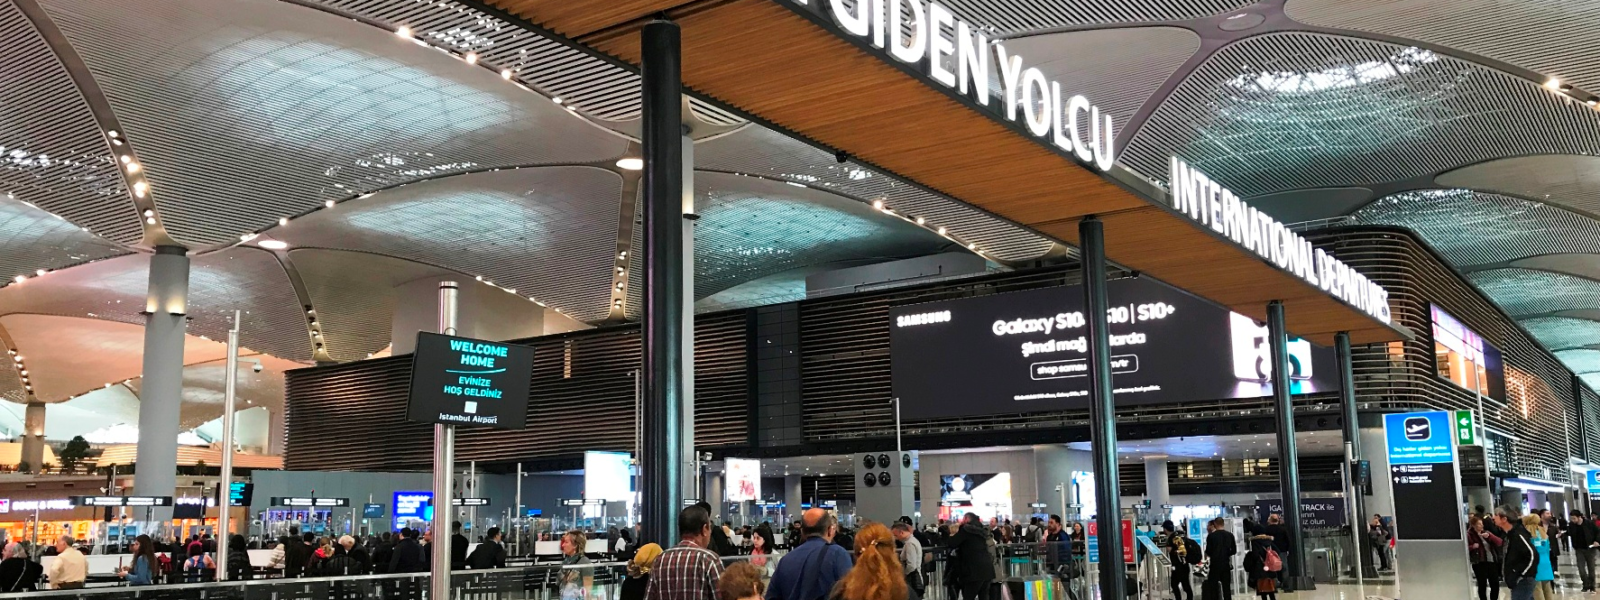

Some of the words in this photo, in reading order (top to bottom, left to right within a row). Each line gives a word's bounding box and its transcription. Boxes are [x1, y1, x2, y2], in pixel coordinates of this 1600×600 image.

[990, 41, 1114, 172] YOLCU
[1169, 156, 1319, 286] INTERNATIONAL
[1314, 247, 1391, 325] DEPARTURES
[897, 310, 951, 327] SAMSUNG
[992, 317, 1054, 336] Galaxy
[1137, 301, 1176, 320] S10+
[450, 339, 508, 357] WELCOME
[460, 354, 495, 368] HOME
[458, 375, 491, 387] EVİNİZE
[443, 385, 462, 396] HOŞ
[464, 387, 502, 399] GELDİNİZ
[472, 415, 498, 424] Airport
[1301, 503, 1325, 511] TRACK
